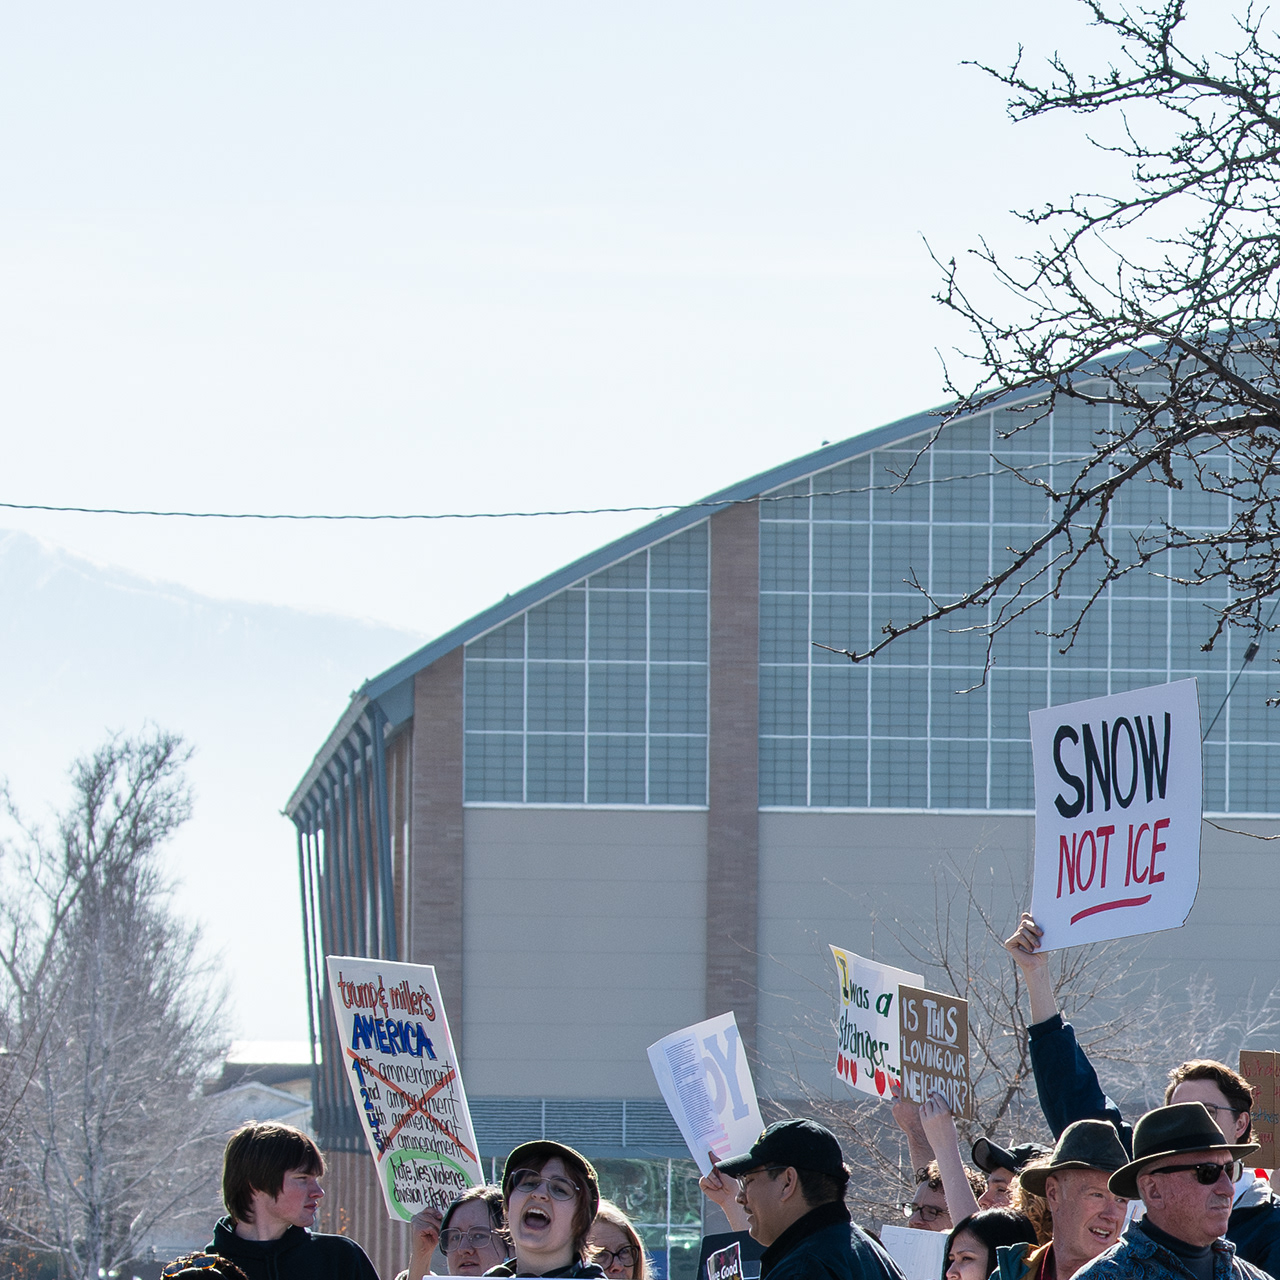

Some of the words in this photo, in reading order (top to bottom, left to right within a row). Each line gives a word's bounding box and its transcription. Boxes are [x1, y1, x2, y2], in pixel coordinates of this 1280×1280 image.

[1053, 711, 1171, 819] SNOW
[1056, 825, 1115, 899] NOT
[1124, 817, 1171, 888] ICE
[849, 979, 870, 1010] was
[875, 992, 894, 1017] a
[902, 997, 919, 1032] IS
[923, 999, 959, 1044] THIS
[352, 1012, 438, 1062] AMERICA
[943, 1051, 966, 1078] OUR
[721, 1259, 738, 1280] Good
